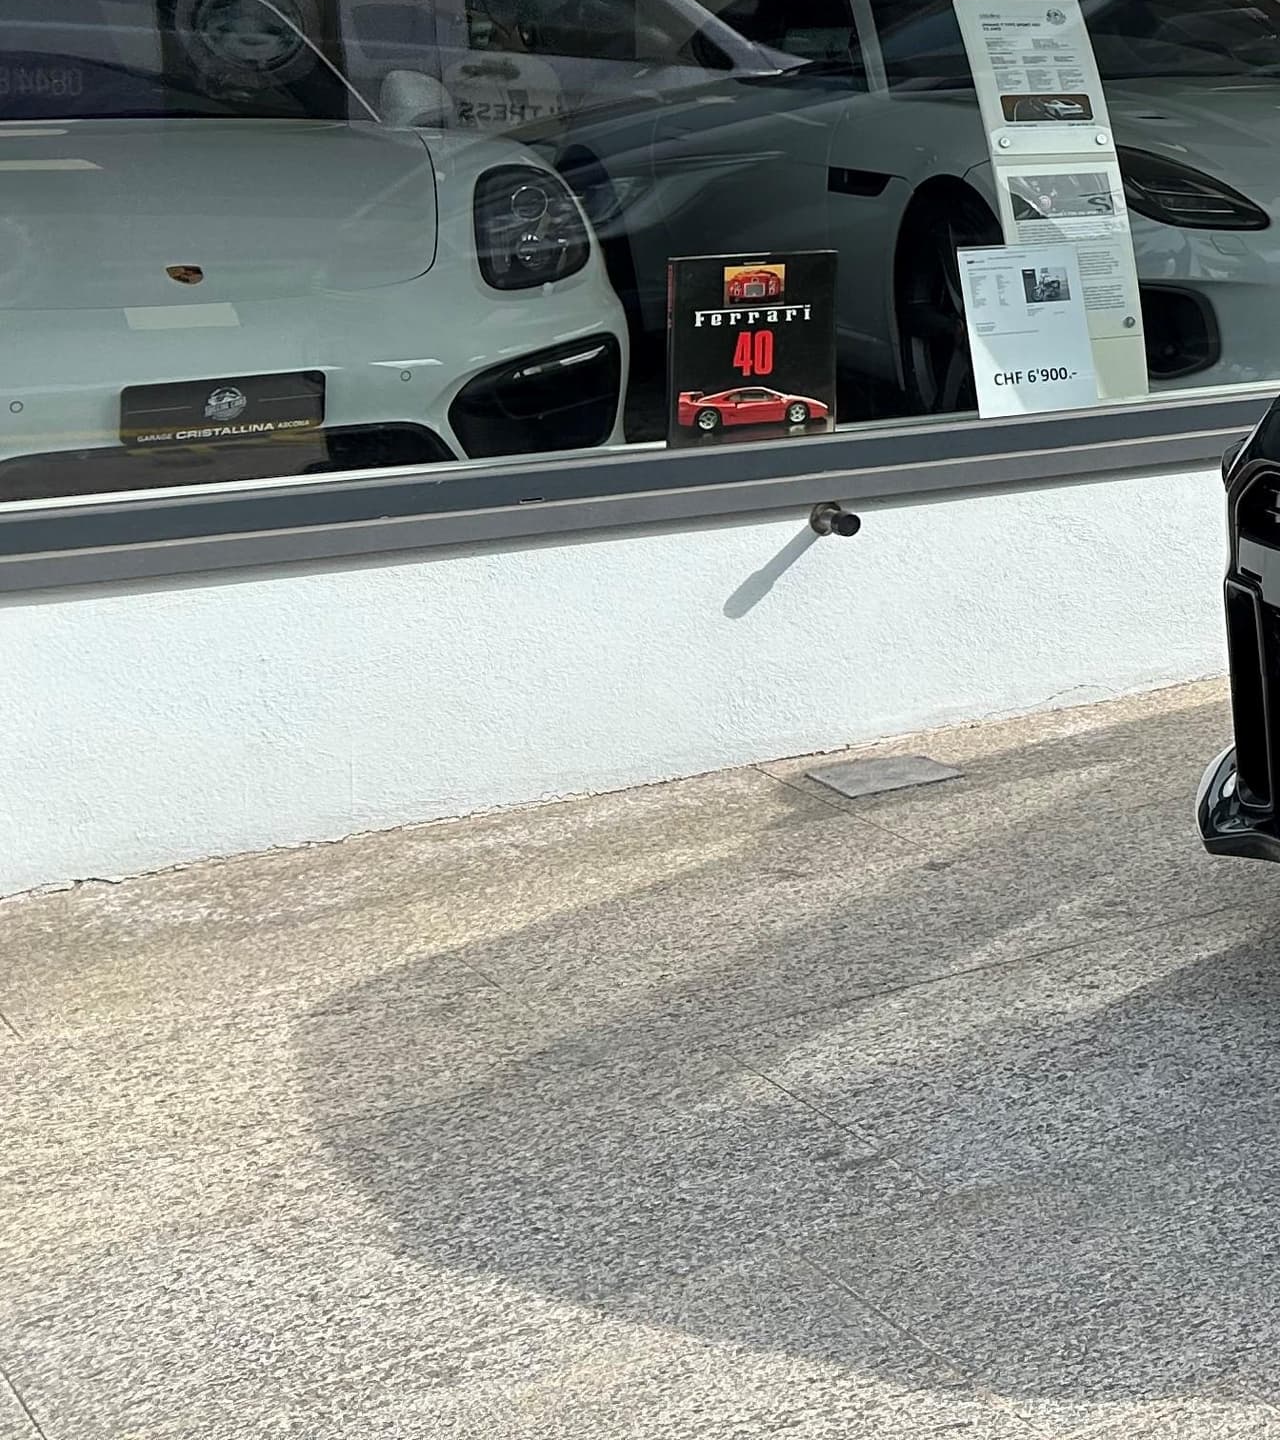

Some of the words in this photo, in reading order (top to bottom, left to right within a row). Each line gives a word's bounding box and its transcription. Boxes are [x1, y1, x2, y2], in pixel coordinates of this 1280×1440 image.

[694, 304, 812, 328] Ferrari
[732, 329, 775, 377] 40
[993, 370, 1023, 386] CHF
[1027, 366, 1078, 384] 6'900.-
[175, 422, 275, 441] CRISTALLINA
